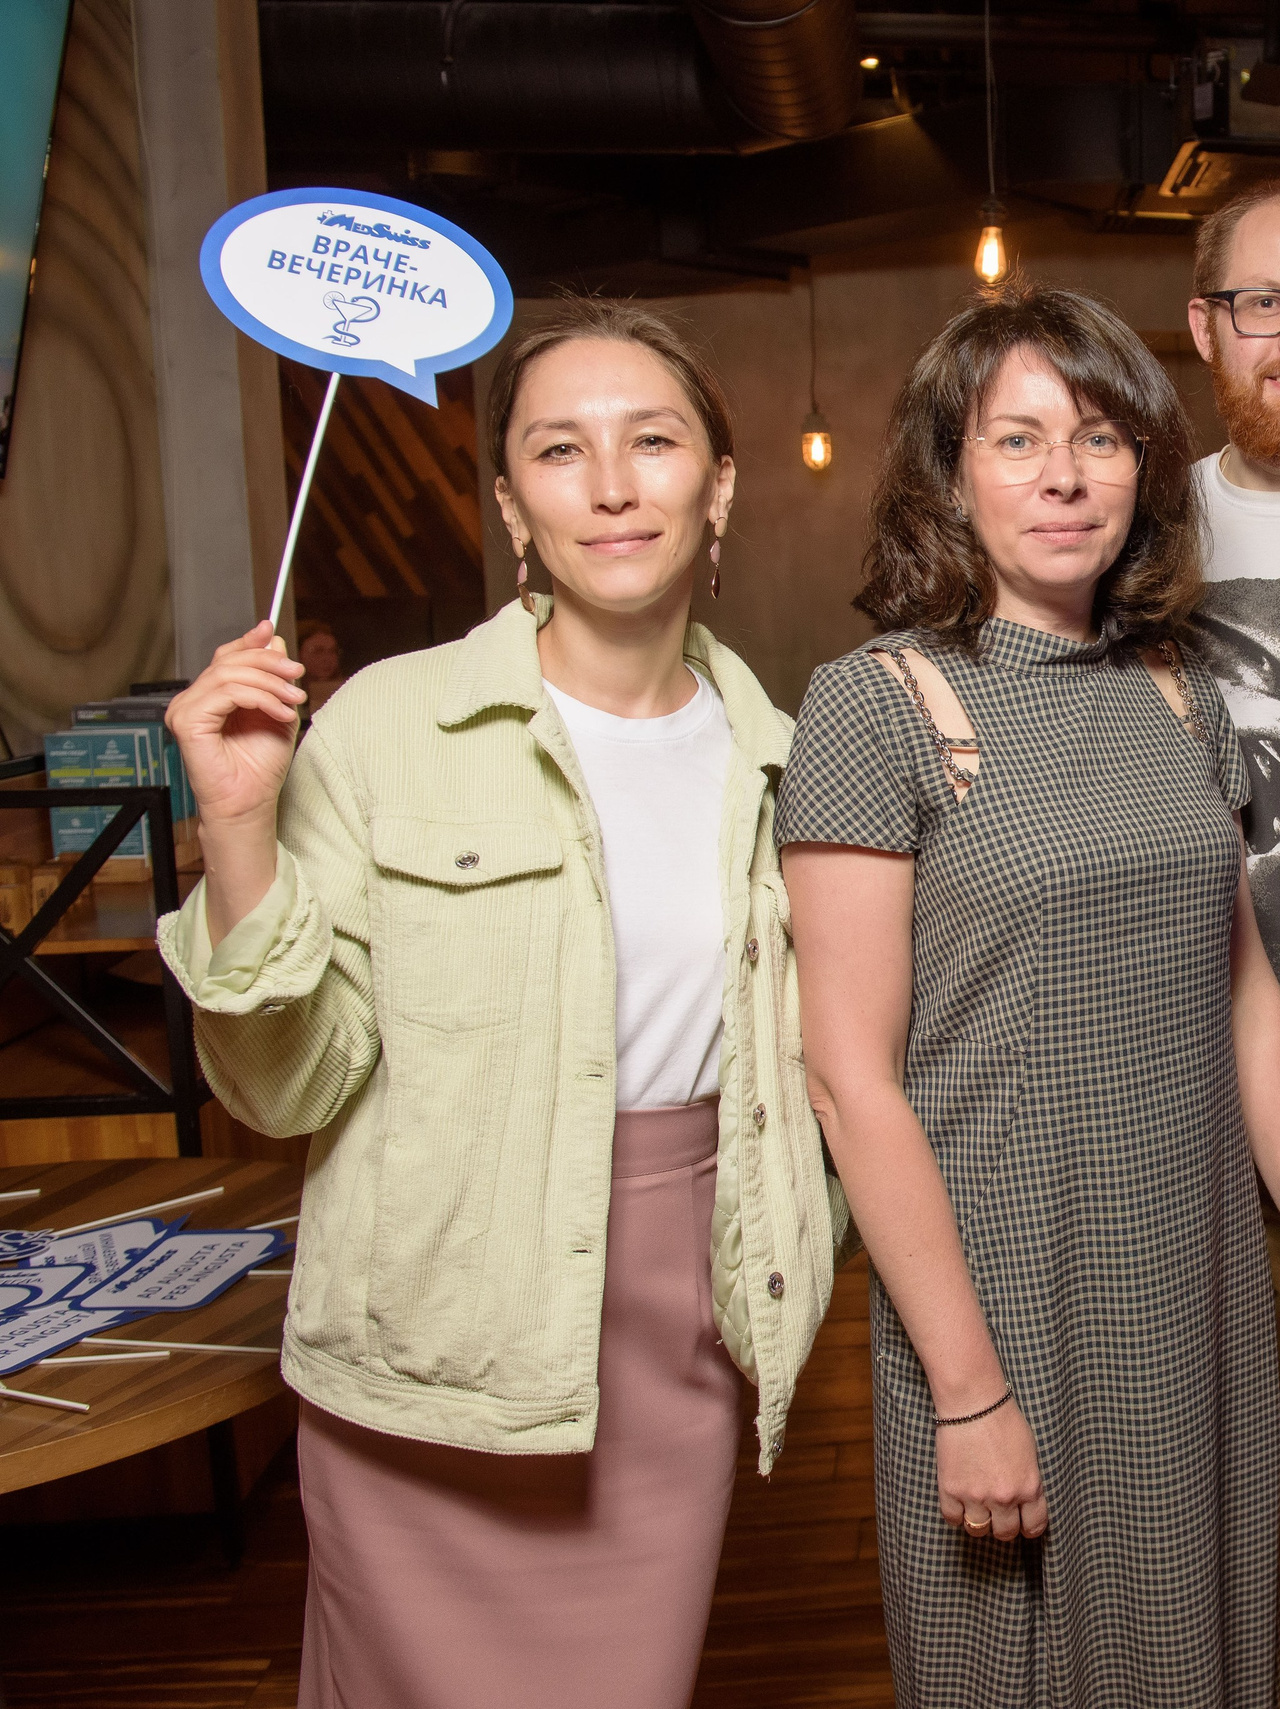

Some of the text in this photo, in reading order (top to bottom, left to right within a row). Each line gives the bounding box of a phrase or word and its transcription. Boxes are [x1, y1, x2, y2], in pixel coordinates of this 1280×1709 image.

[267, 249, 448, 309] ВЕЧЕРИНКА
[311, 234, 419, 274] ВРАЧЕ-
[137, 1243, 220, 1299] AD AUGUSTA
[161, 1240, 250, 1301] PER ANGUSTA
